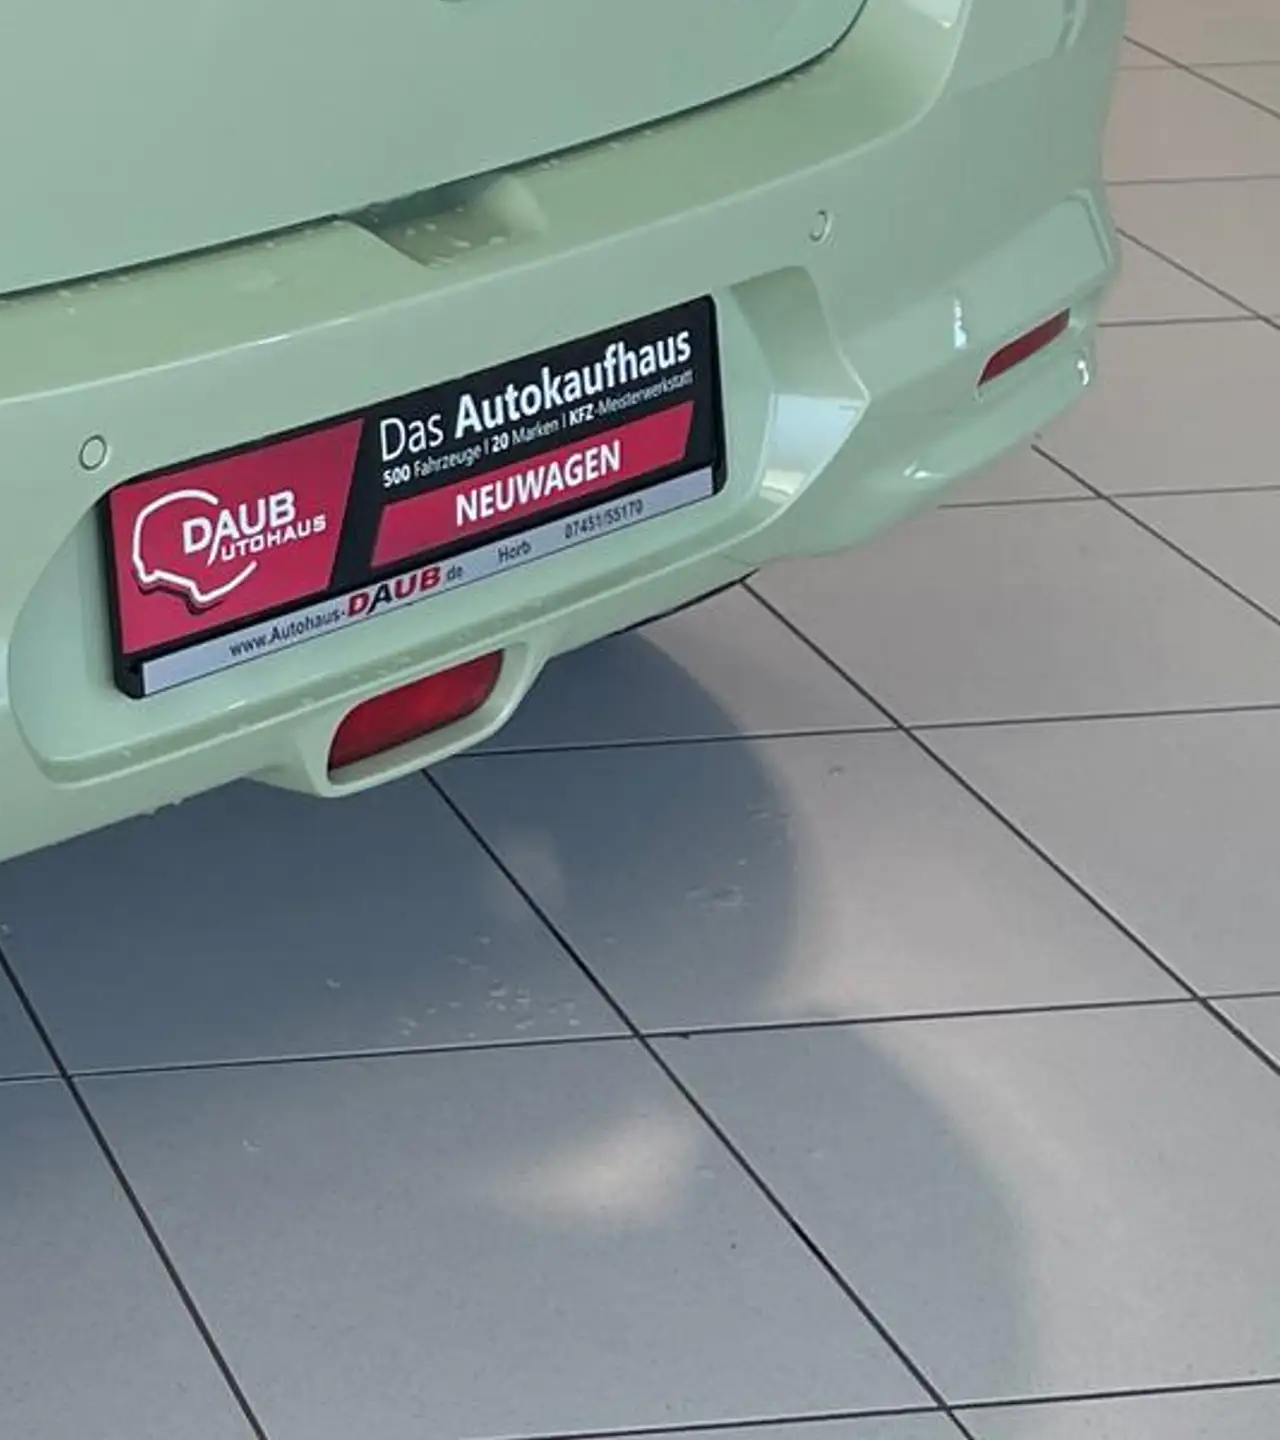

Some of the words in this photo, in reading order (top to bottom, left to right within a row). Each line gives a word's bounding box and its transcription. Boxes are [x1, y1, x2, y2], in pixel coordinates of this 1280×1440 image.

[380, 413, 444, 462] Das
[454, 329, 692, 440] Autokaufhaus
[382, 466, 411, 489] 500
[413, 442, 482, 478] Fahrzeuge
[491, 433, 510, 454] 20
[511, 418, 560, 445] Marken
[569, 369, 694, 428] KFZ-Meisterwerkstatt
[455, 440, 622, 527] NEUWAGEN
[183, 490, 297, 566] DAUB
[498, 539, 532, 565] Horb
